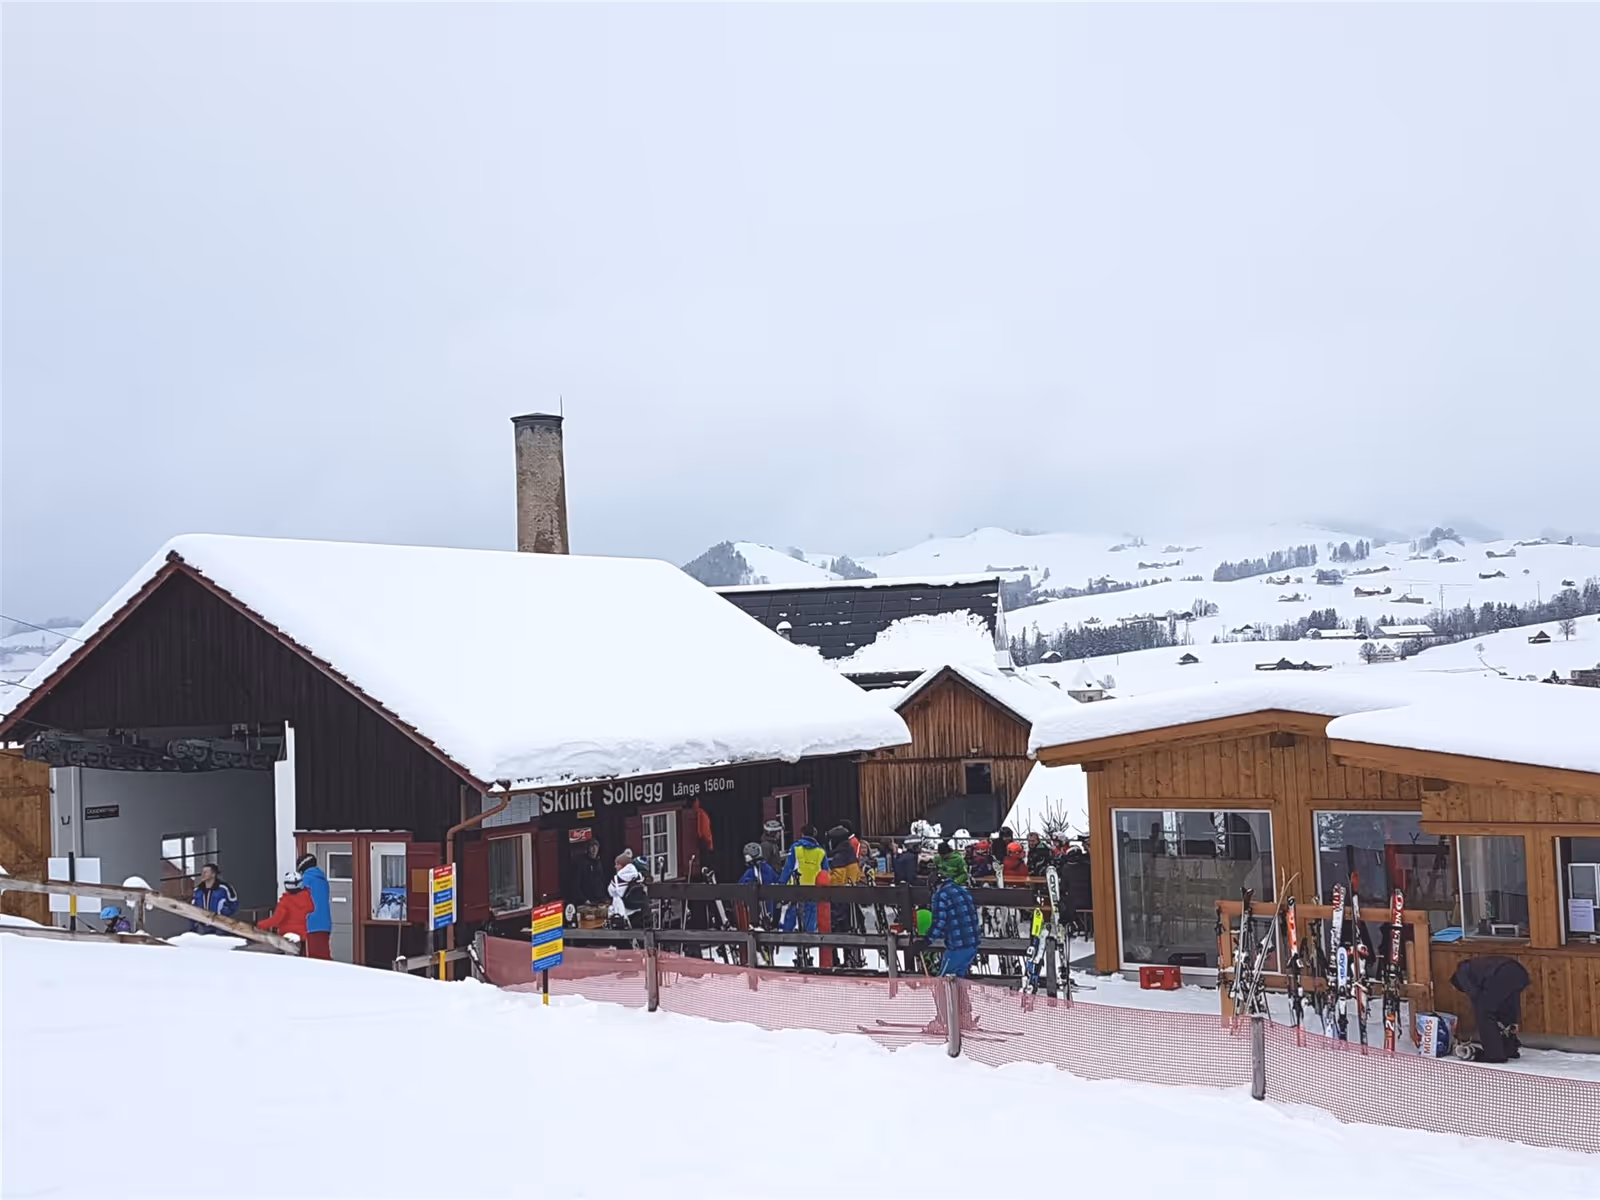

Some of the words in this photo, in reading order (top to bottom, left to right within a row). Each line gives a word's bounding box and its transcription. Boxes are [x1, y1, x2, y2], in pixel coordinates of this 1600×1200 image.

[542, 786, 593, 814] Skilift
[603, 781, 663, 805] Sollegg
[672, 782, 700, 796] Länge
[1424, 1019, 1433, 1054] MIGROS
